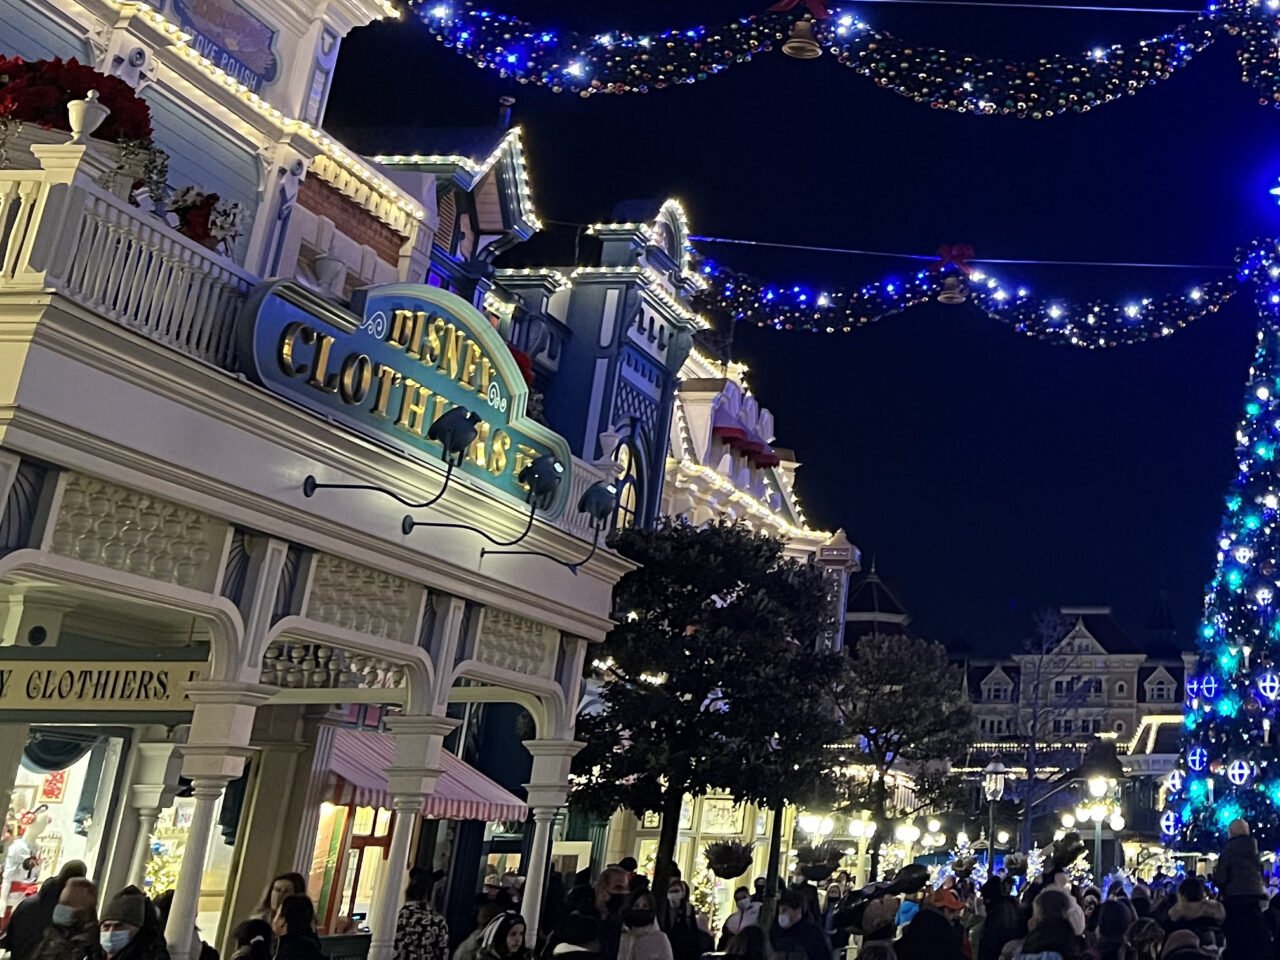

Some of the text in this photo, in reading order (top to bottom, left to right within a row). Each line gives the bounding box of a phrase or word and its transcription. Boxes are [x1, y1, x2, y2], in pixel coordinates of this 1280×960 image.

[220, 52, 258, 92] POLISH
[278, 321, 511, 477] CLOTHIRS
[388, 309, 497, 401] DISNEY
